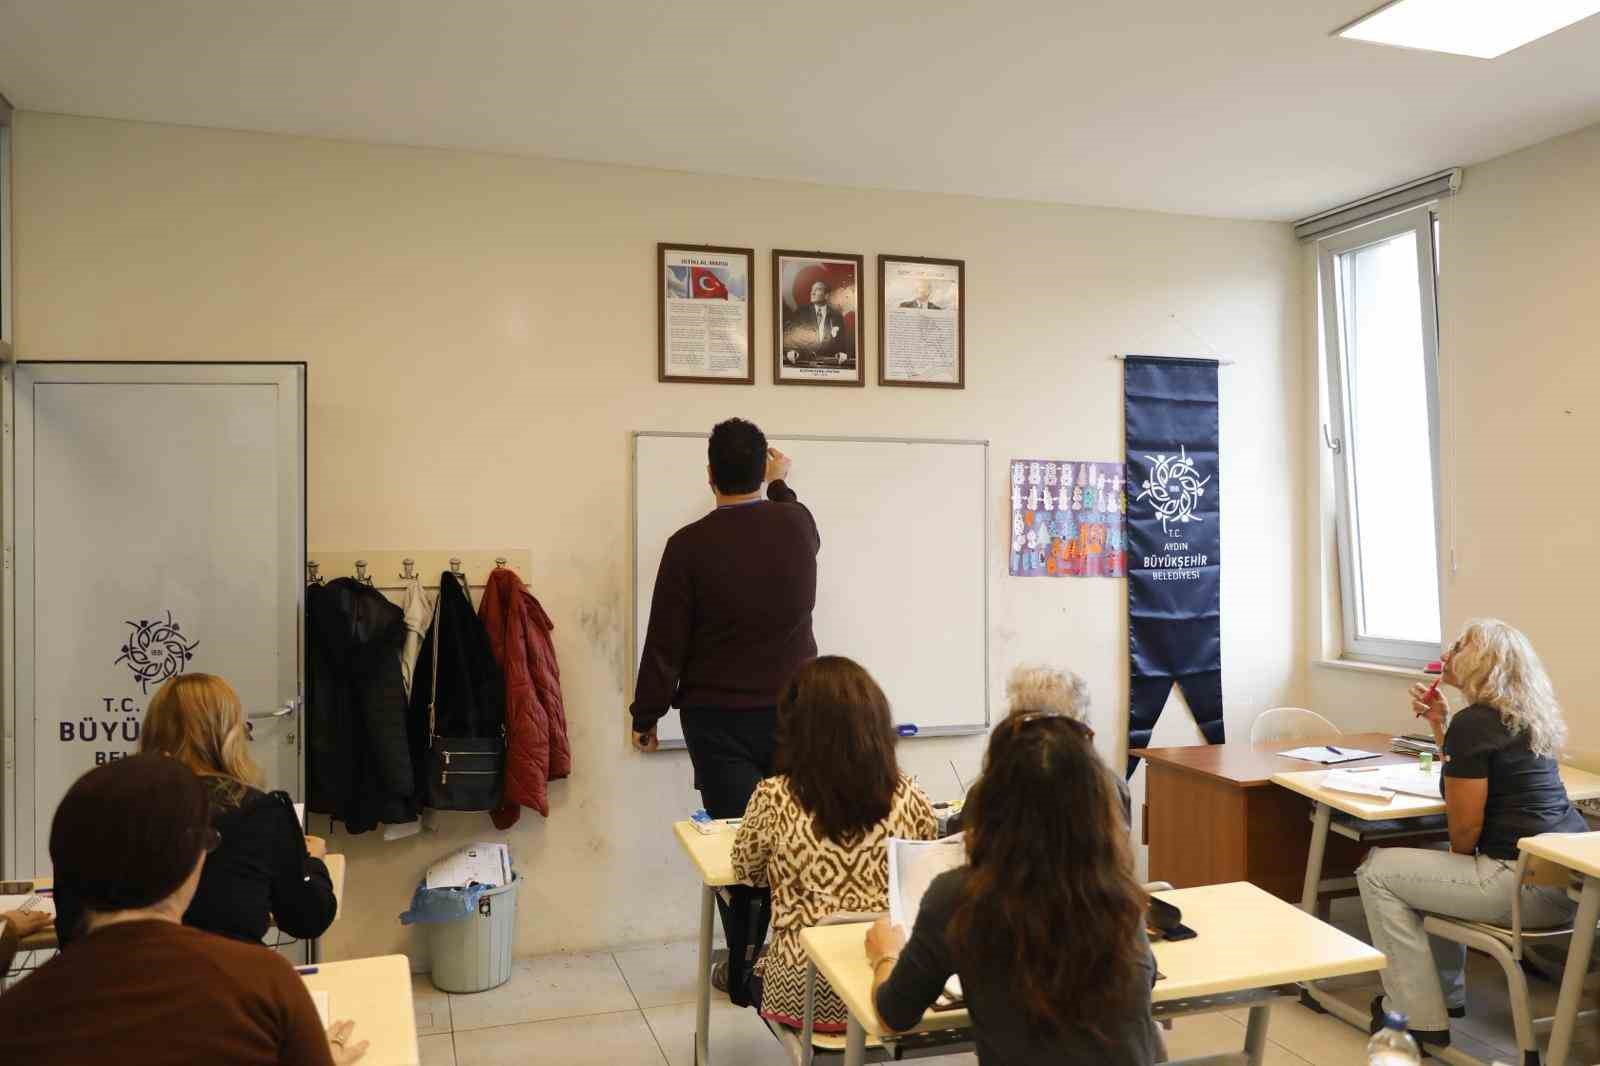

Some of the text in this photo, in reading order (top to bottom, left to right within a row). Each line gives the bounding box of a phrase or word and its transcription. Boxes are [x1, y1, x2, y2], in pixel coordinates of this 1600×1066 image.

[1164, 542, 1188, 552] AYDIN
[1143, 553, 1208, 569] BÜYÜKŞEHİR
[1152, 568, 1201, 581] BELEDİYESİ
[102, 697, 141, 713] T.C.
